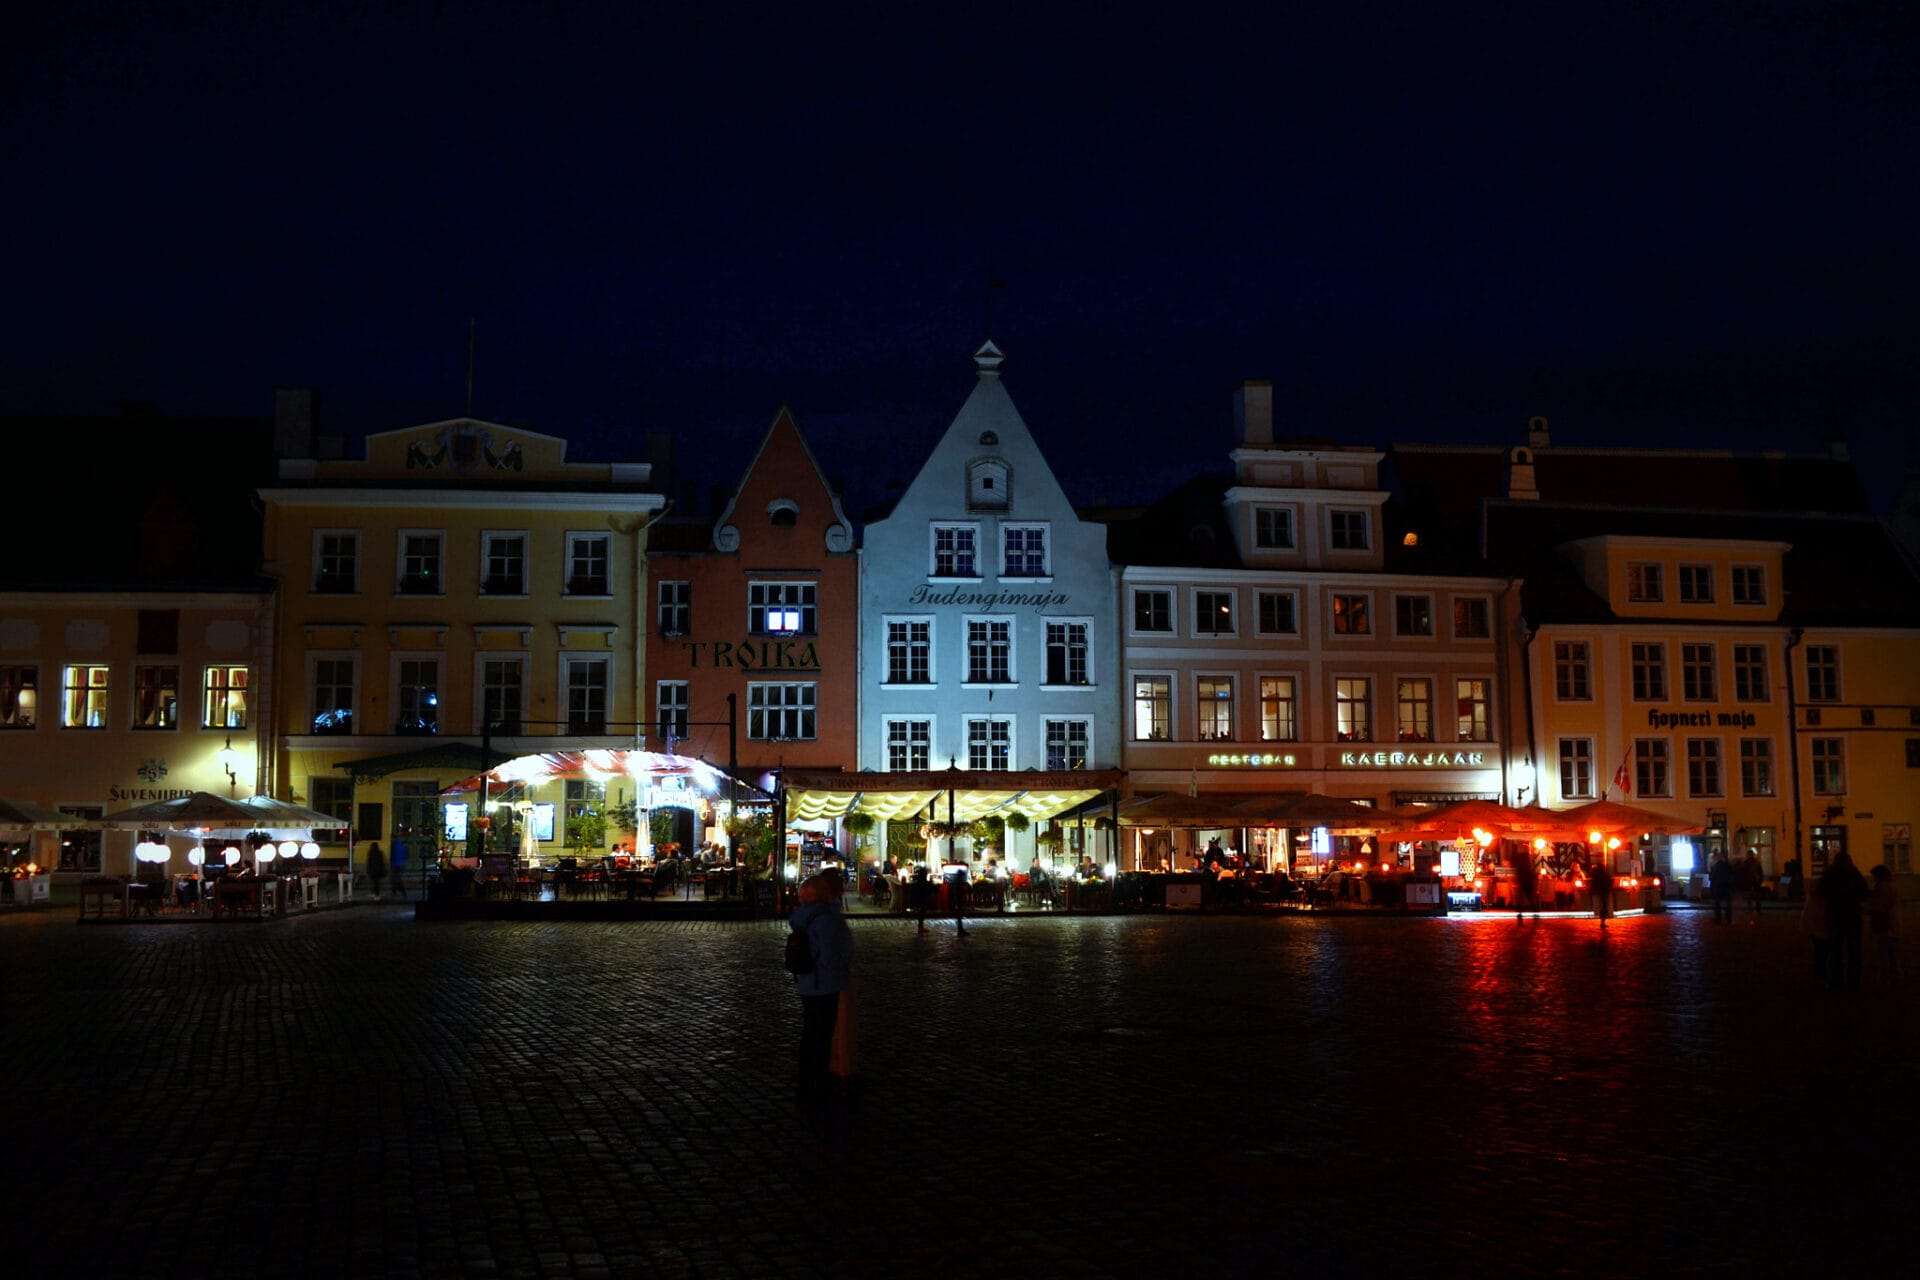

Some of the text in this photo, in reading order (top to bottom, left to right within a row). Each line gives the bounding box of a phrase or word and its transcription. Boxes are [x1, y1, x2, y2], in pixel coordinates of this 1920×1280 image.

[909, 584, 1071, 613] Tudengimaja
[682, 640, 821, 667] TROIKA
[1717, 710, 1756, 729] maja
[1341, 752, 1484, 766] KAERAJAAN
